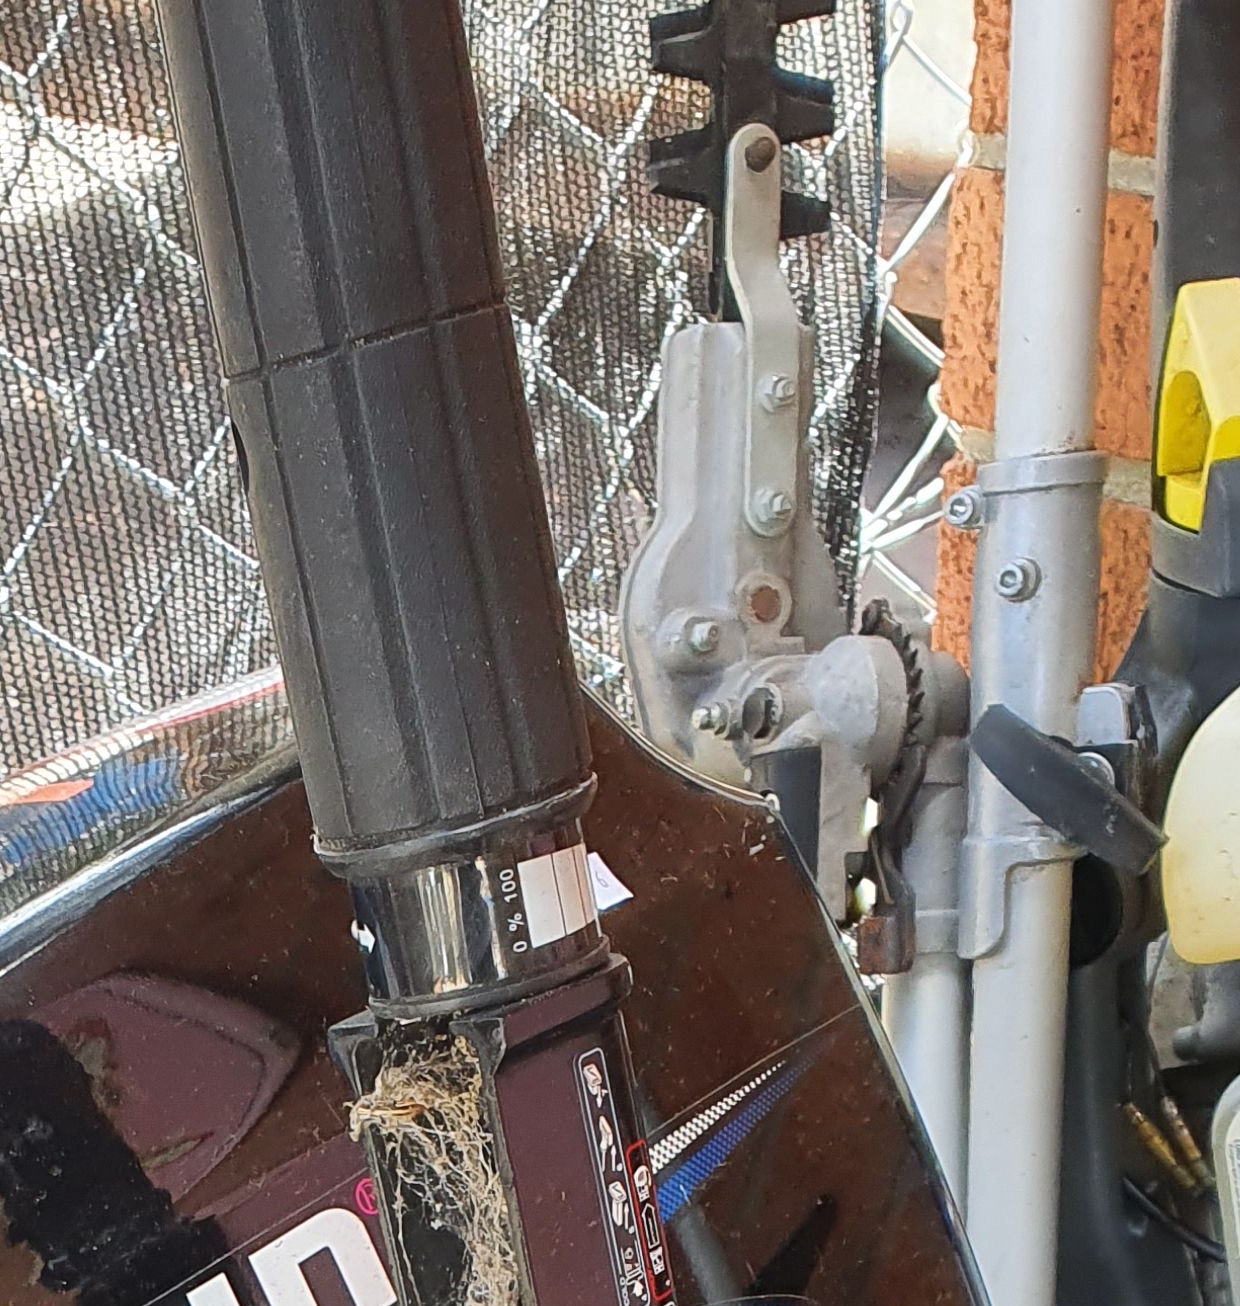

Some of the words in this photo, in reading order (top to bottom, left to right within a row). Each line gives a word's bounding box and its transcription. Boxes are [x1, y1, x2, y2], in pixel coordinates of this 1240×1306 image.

[499, 868, 519, 904] 100
[508, 912, 525, 932] %
[513, 940, 528, 953] 0
